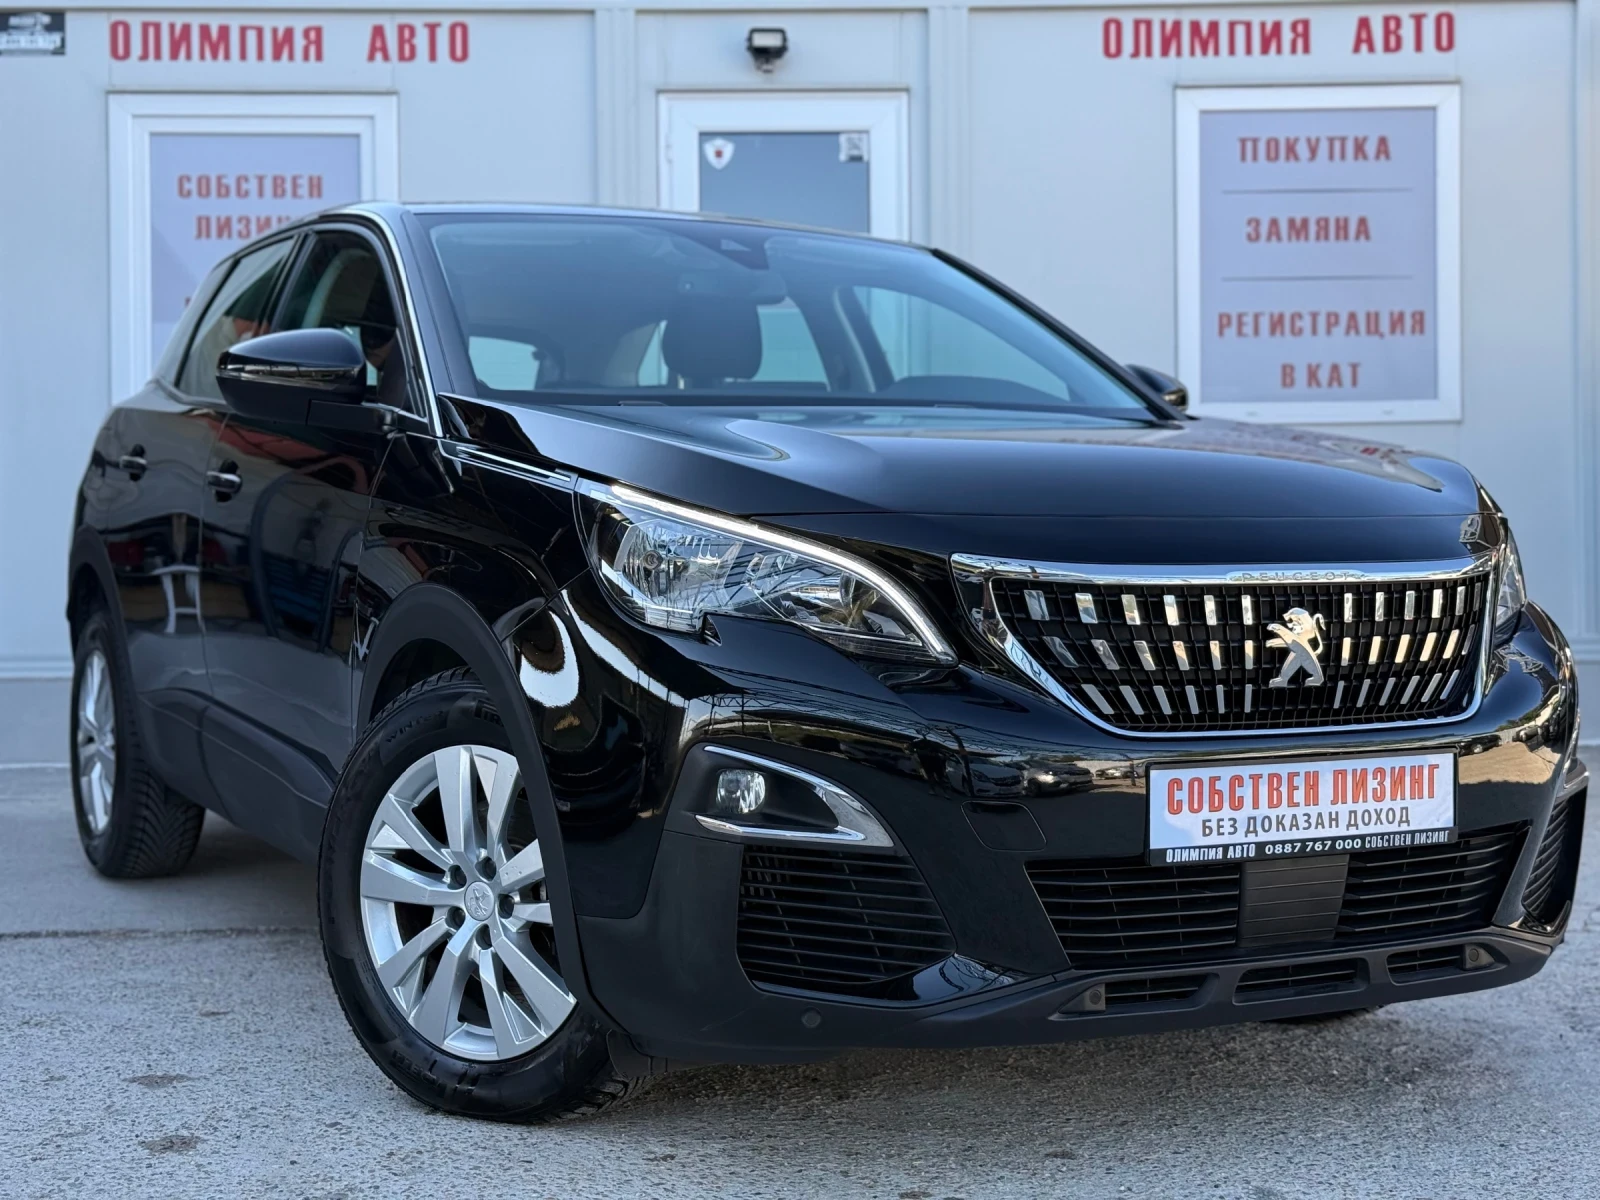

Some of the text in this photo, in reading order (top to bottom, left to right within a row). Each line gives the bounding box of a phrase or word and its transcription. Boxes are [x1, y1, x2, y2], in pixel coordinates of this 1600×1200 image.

[109, 20, 324, 62] ОЛИМПИЯ
[366, 21, 469, 63] АВТО
[1102, 11, 1456, 59] ОЛИМПИЯ АВТО
[1239, 135, 1391, 163] ПОКУПКА
[177, 173, 324, 199] СОБСТВЕН
[195, 214, 293, 240] ЛИЗИ
[1246, 216, 1371, 243] ЗАМЯНА
[1218, 310, 1425, 339] РЕГИСТРАЦИЯ
[1281, 362, 1361, 388] В КАТ
[1242, 571, 1350, 582] PEUGEOT
[1167, 764, 1440, 815] СОБСТВЕН ЛИЗИНГ
[1202, 806, 1411, 838] БЕЗ ДОКАЗАН ДОХОД
[1166, 829, 1450, 863] ОЛИМПИЯ АВТО 0887 767 000 СОБСТВЕН ЛИЗИНГ
